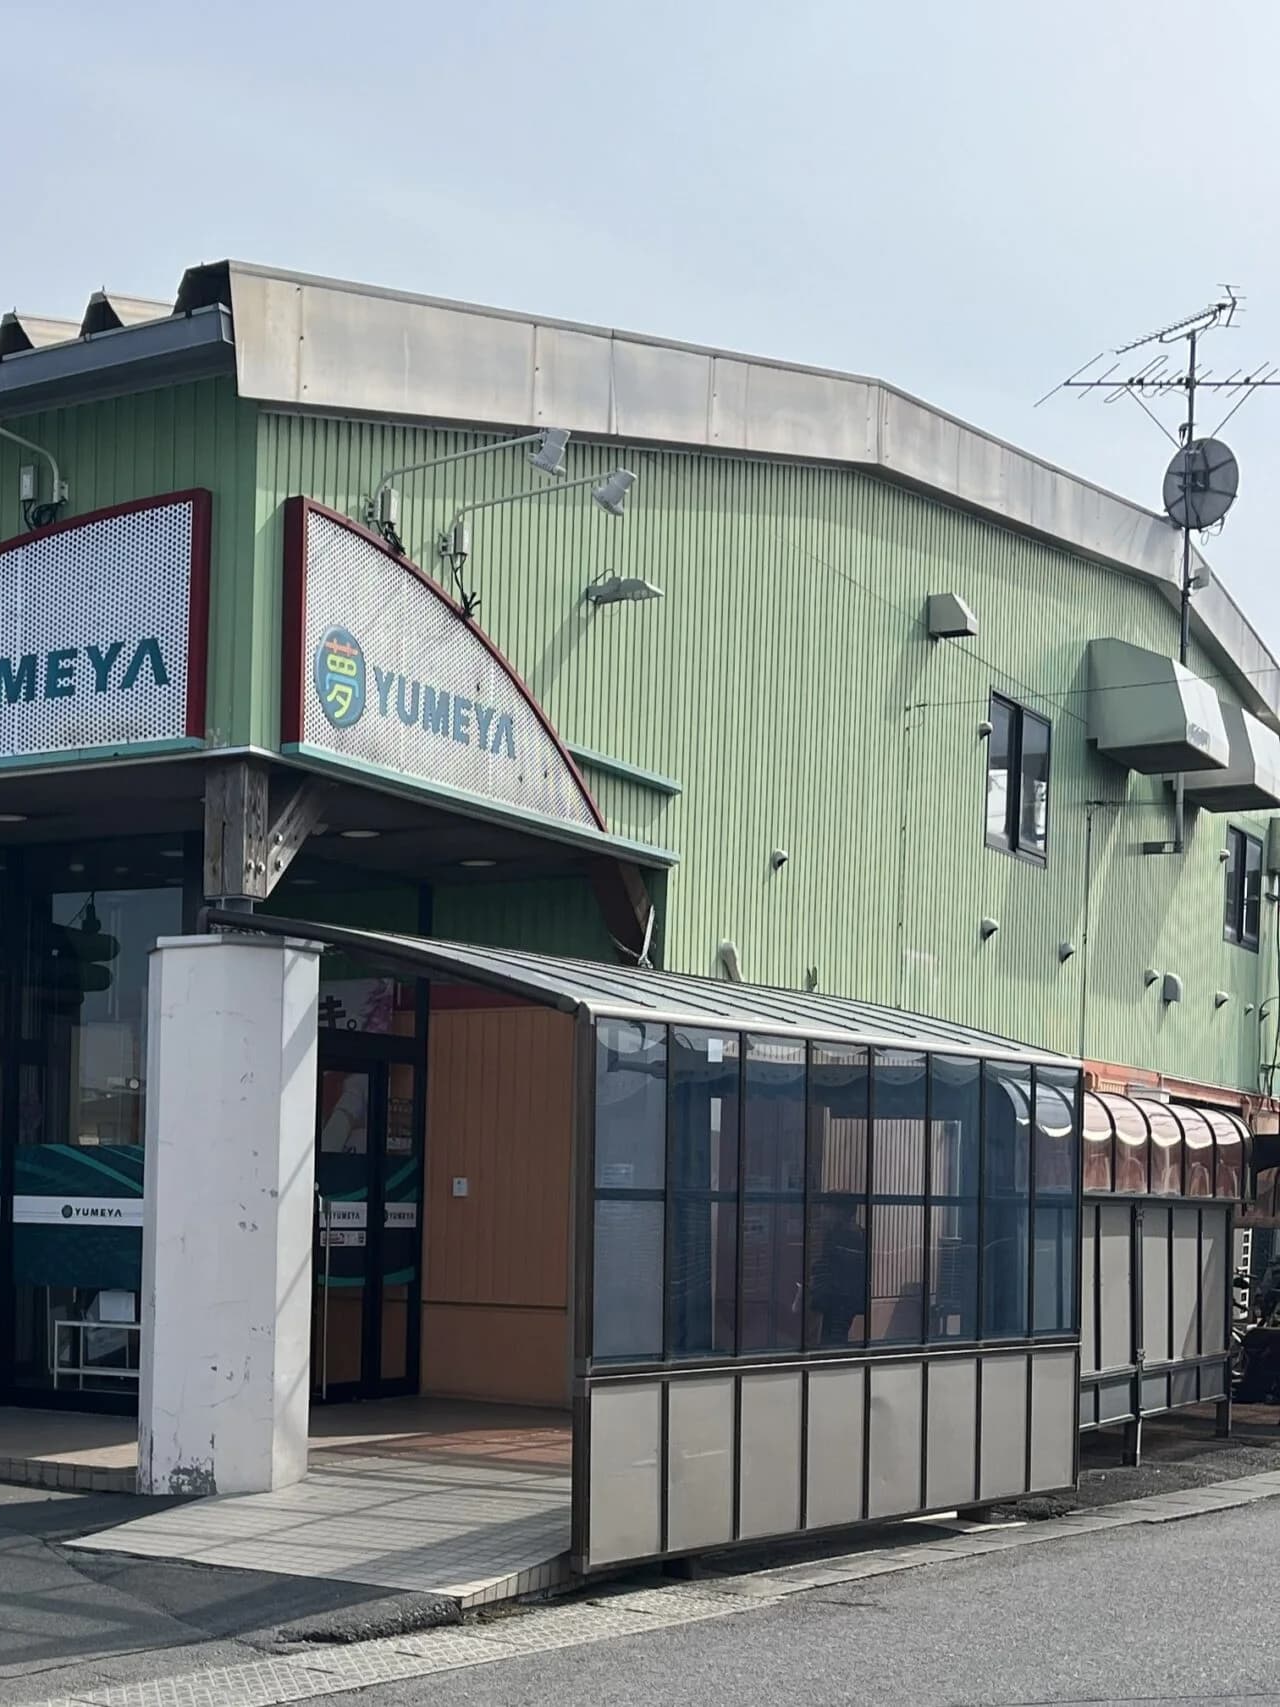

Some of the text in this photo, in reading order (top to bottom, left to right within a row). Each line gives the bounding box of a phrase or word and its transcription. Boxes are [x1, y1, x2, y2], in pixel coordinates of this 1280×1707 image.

[323, 636, 517, 761] 夢 YUMEYA
[74, 1207, 122, 1218] YUMEYA
